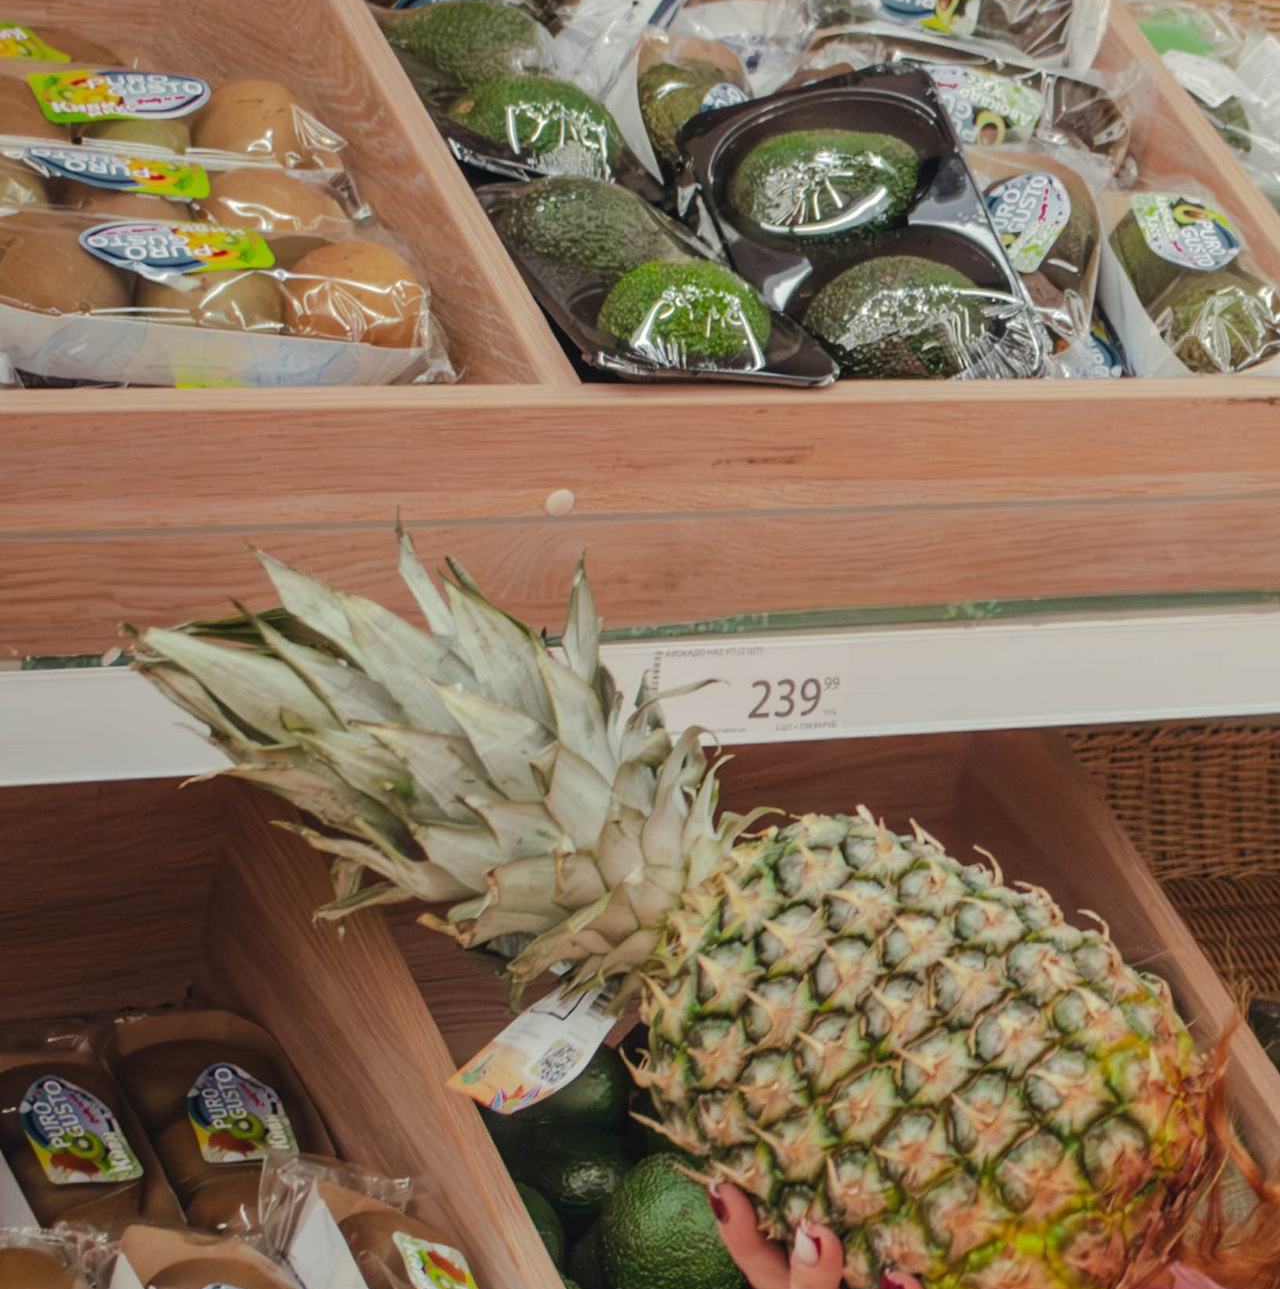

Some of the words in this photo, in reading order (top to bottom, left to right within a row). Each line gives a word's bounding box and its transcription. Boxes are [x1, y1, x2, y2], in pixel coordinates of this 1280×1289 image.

[86, 74, 168, 89] PURO
[108, 81, 204, 97] GUSTO
[64, 160, 150, 179] PURO
[994, 188, 1020, 230] URO
[1007, 176, 1049, 232] GUSTO
[86, 234, 190, 249] GUSTO
[124, 243, 213, 260] PURO
[1181, 226, 1215, 267] GUSTO
[1199, 219, 1226, 256] PURO
[748, 678, 821, 719] 239
[824, 676, 841, 690] 99
[44, 1080, 85, 1138] GUSTO
[202, 1088, 233, 1129] PURO
[214, 1067, 248, 1120] GUSTO
[33, 1101, 73, 1149] PURO
